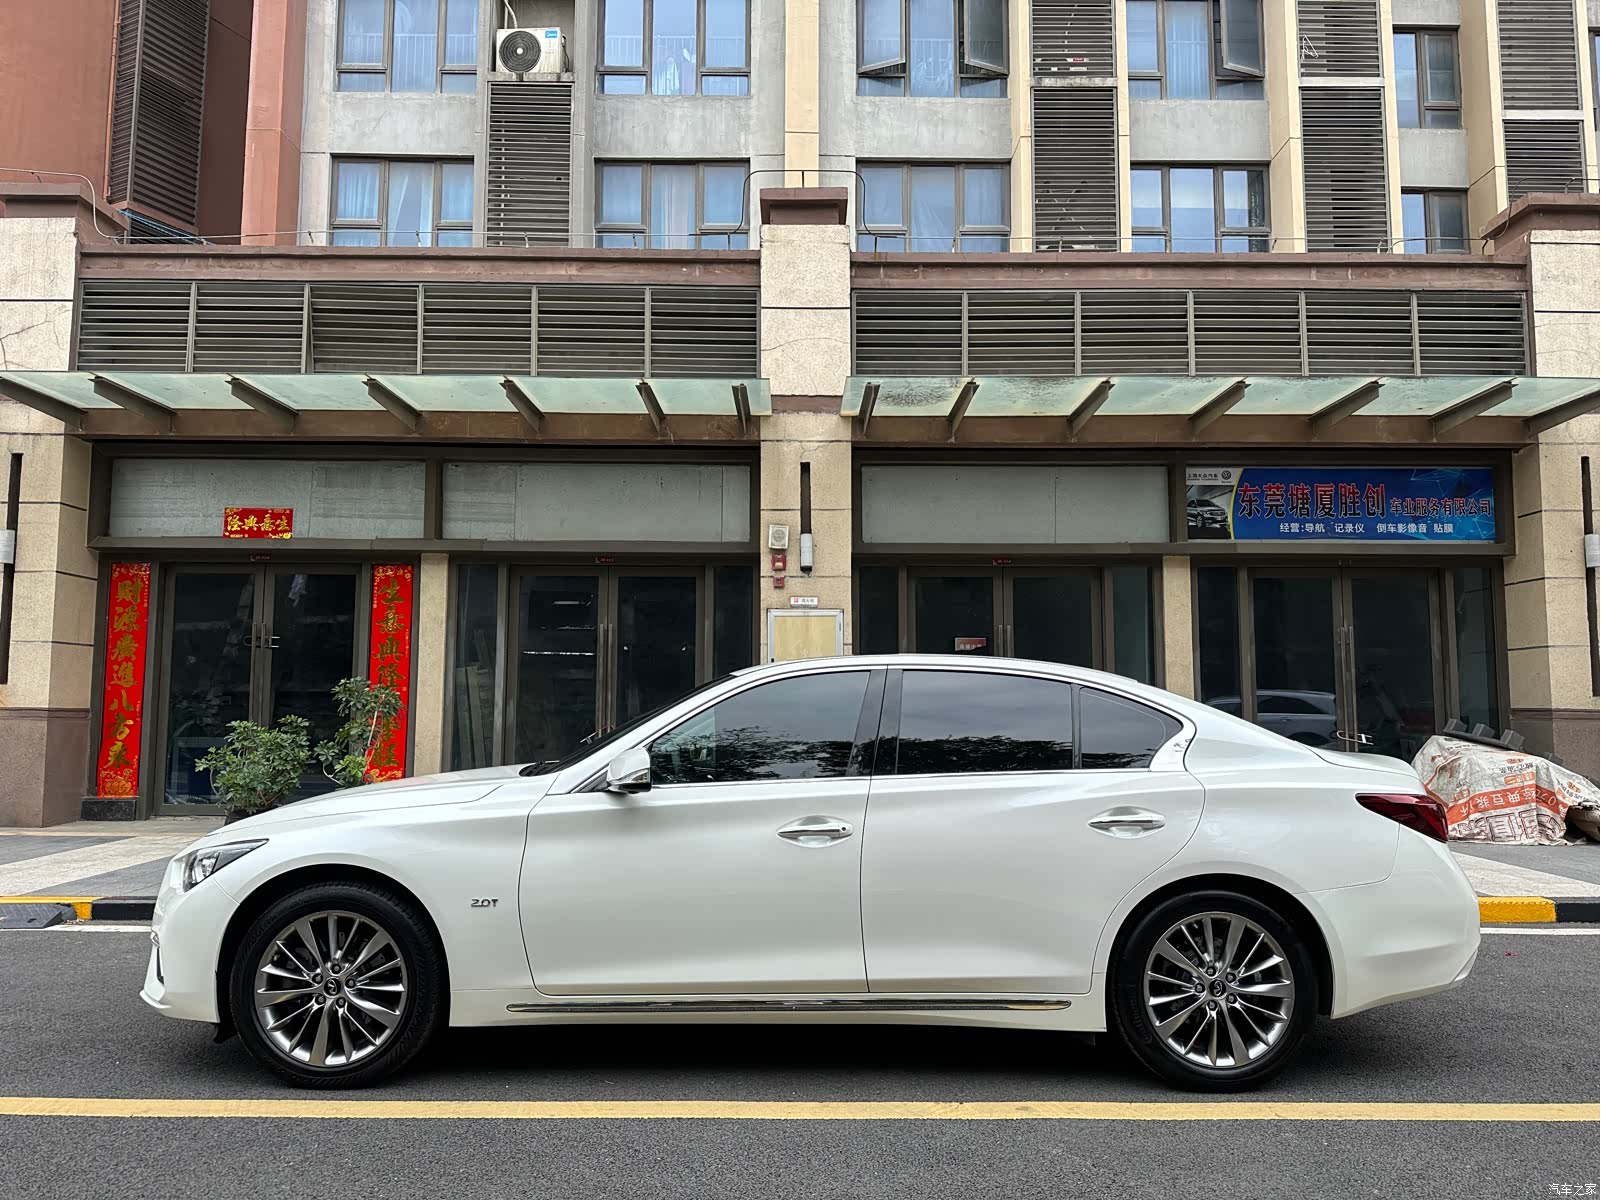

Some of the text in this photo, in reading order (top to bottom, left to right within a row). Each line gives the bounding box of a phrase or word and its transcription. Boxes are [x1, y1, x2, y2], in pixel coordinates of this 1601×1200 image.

[1238, 482, 1492, 518] 东莞塘厦胜创 车业服务有限公司
[1334, 522, 1365, 533] 记录仪
[1376, 522, 1428, 533] 倒车影像音
[1433, 522, 1454, 533] 贴膜
